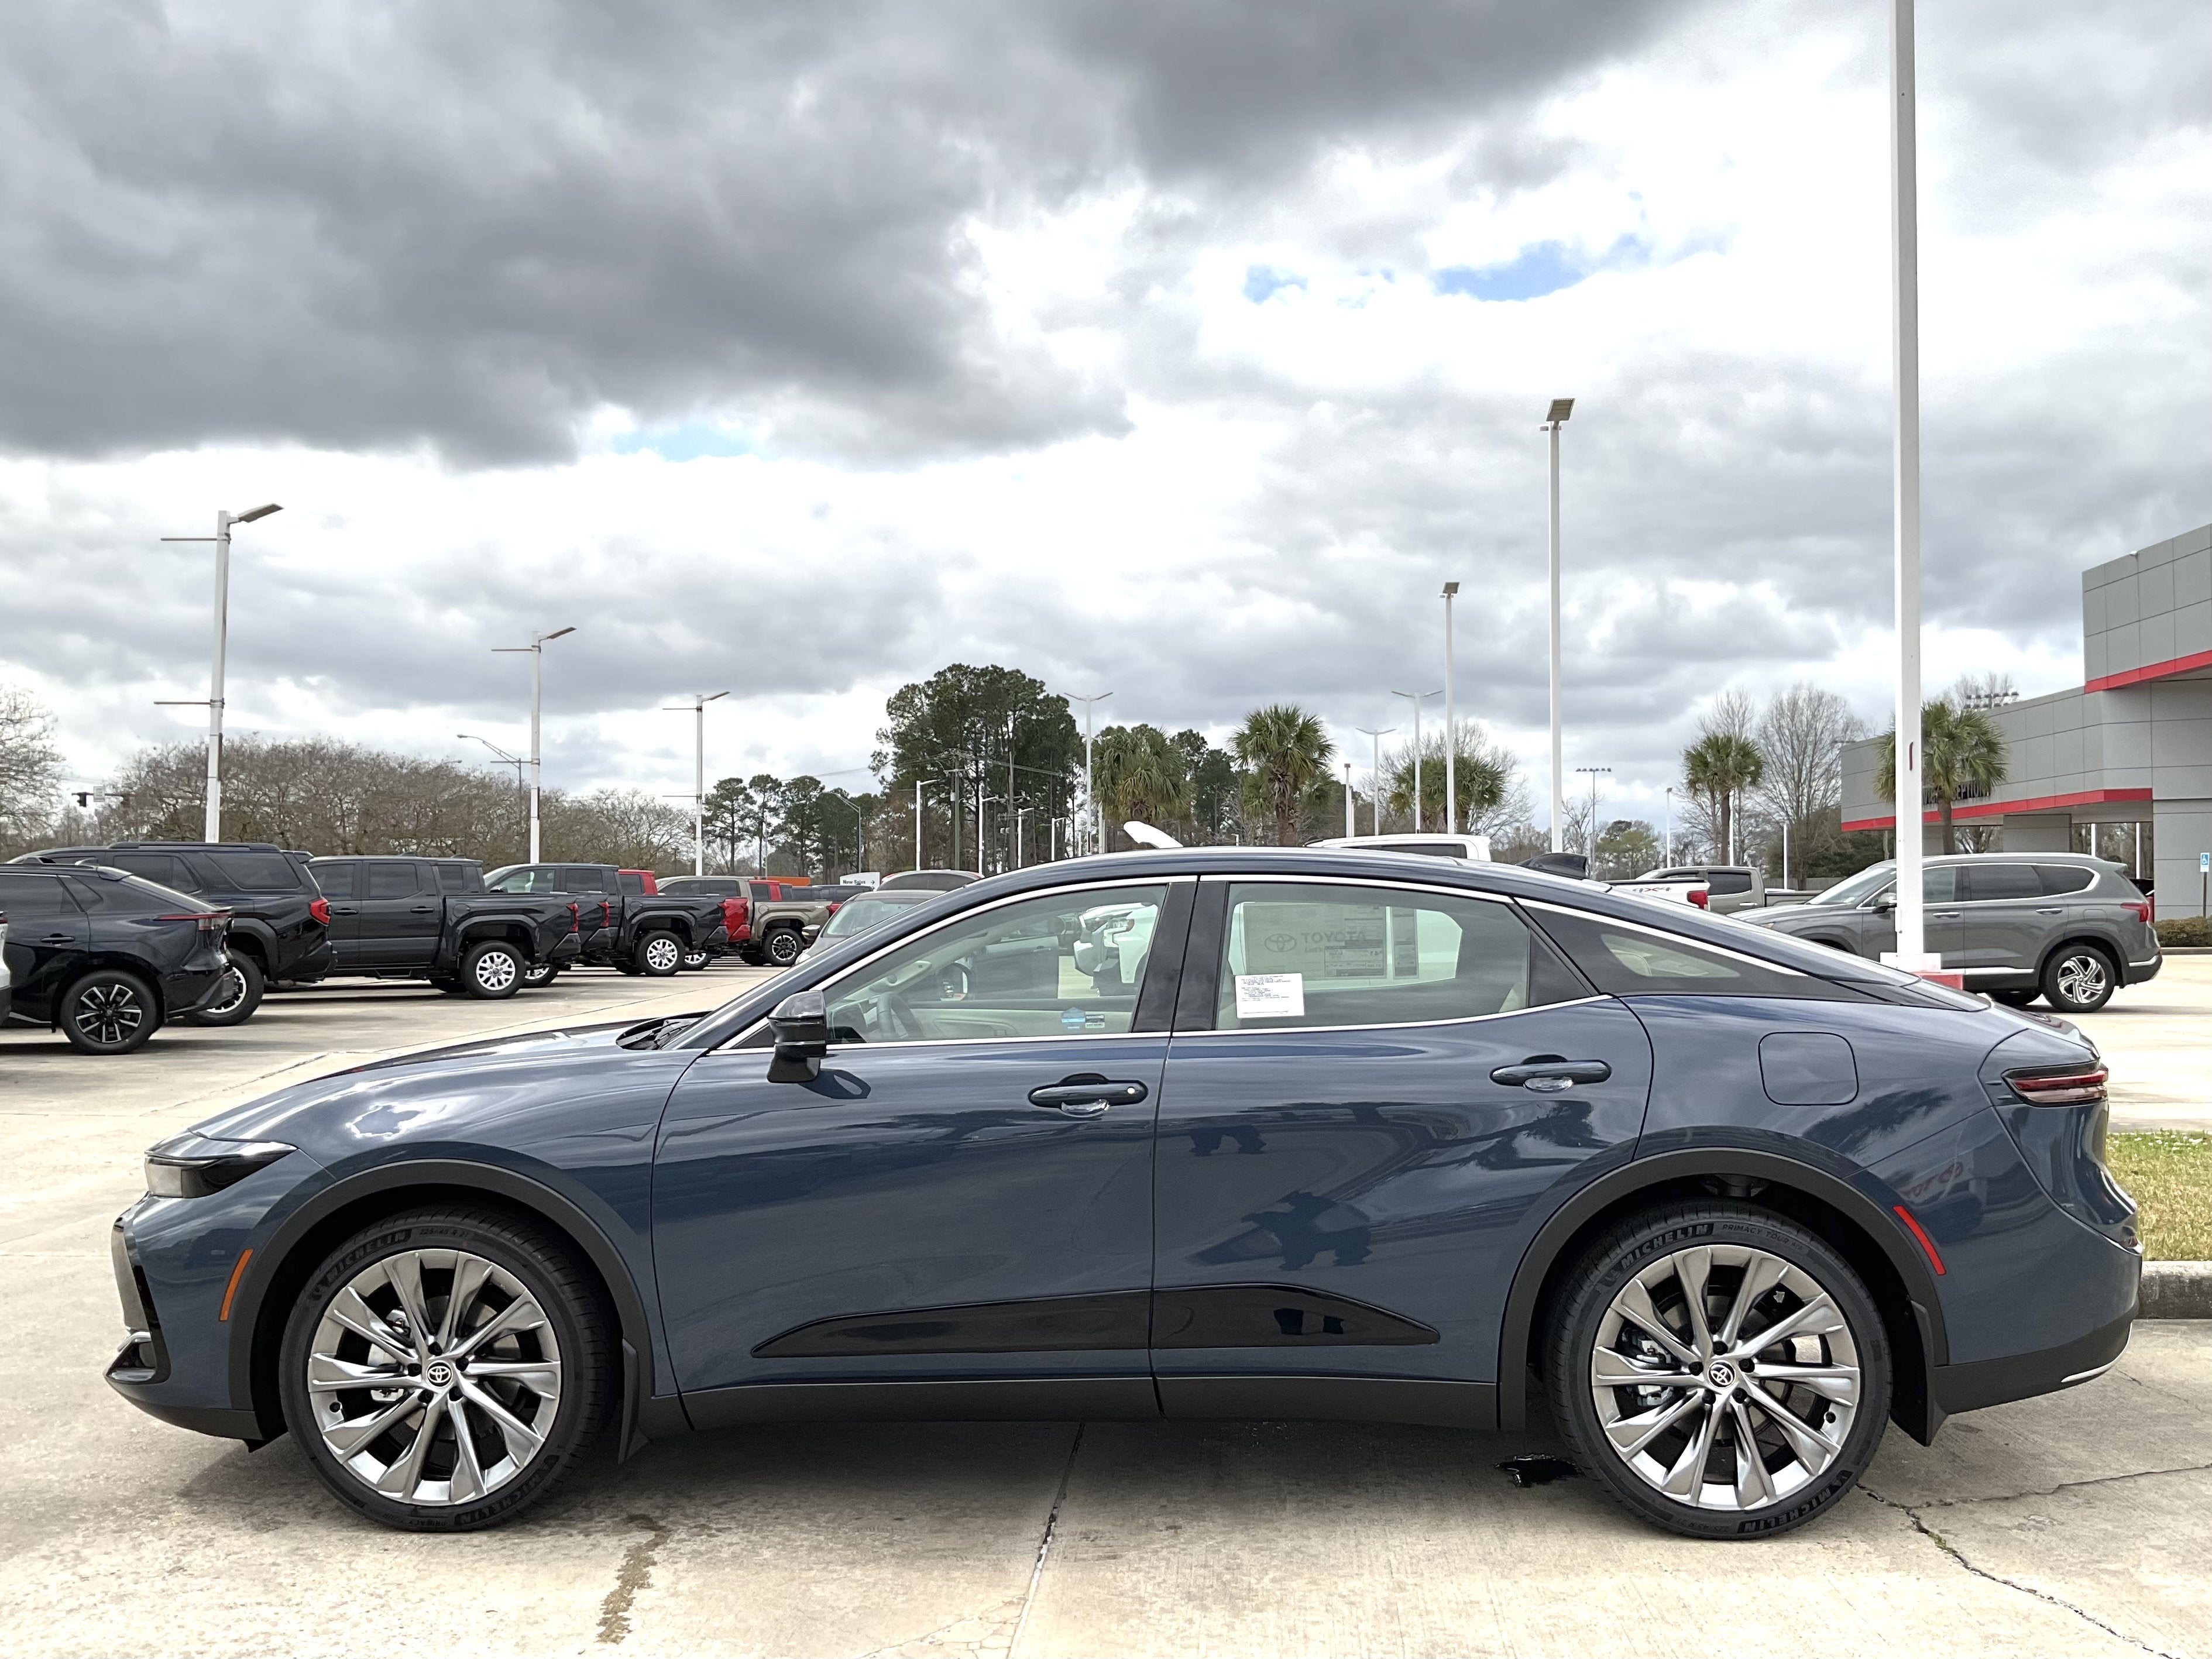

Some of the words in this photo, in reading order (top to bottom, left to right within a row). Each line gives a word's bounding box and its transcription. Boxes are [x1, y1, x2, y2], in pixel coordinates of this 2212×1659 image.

[326, 1231, 406, 1283] MICHELIN
[1621, 1224, 1709, 1269] MICHELIN
[1722, 1224, 1763, 1234] PRIMACY
[1766, 1231, 1789, 1244] TOUR
[1744, 1488, 1831, 1531] MICHELIN
